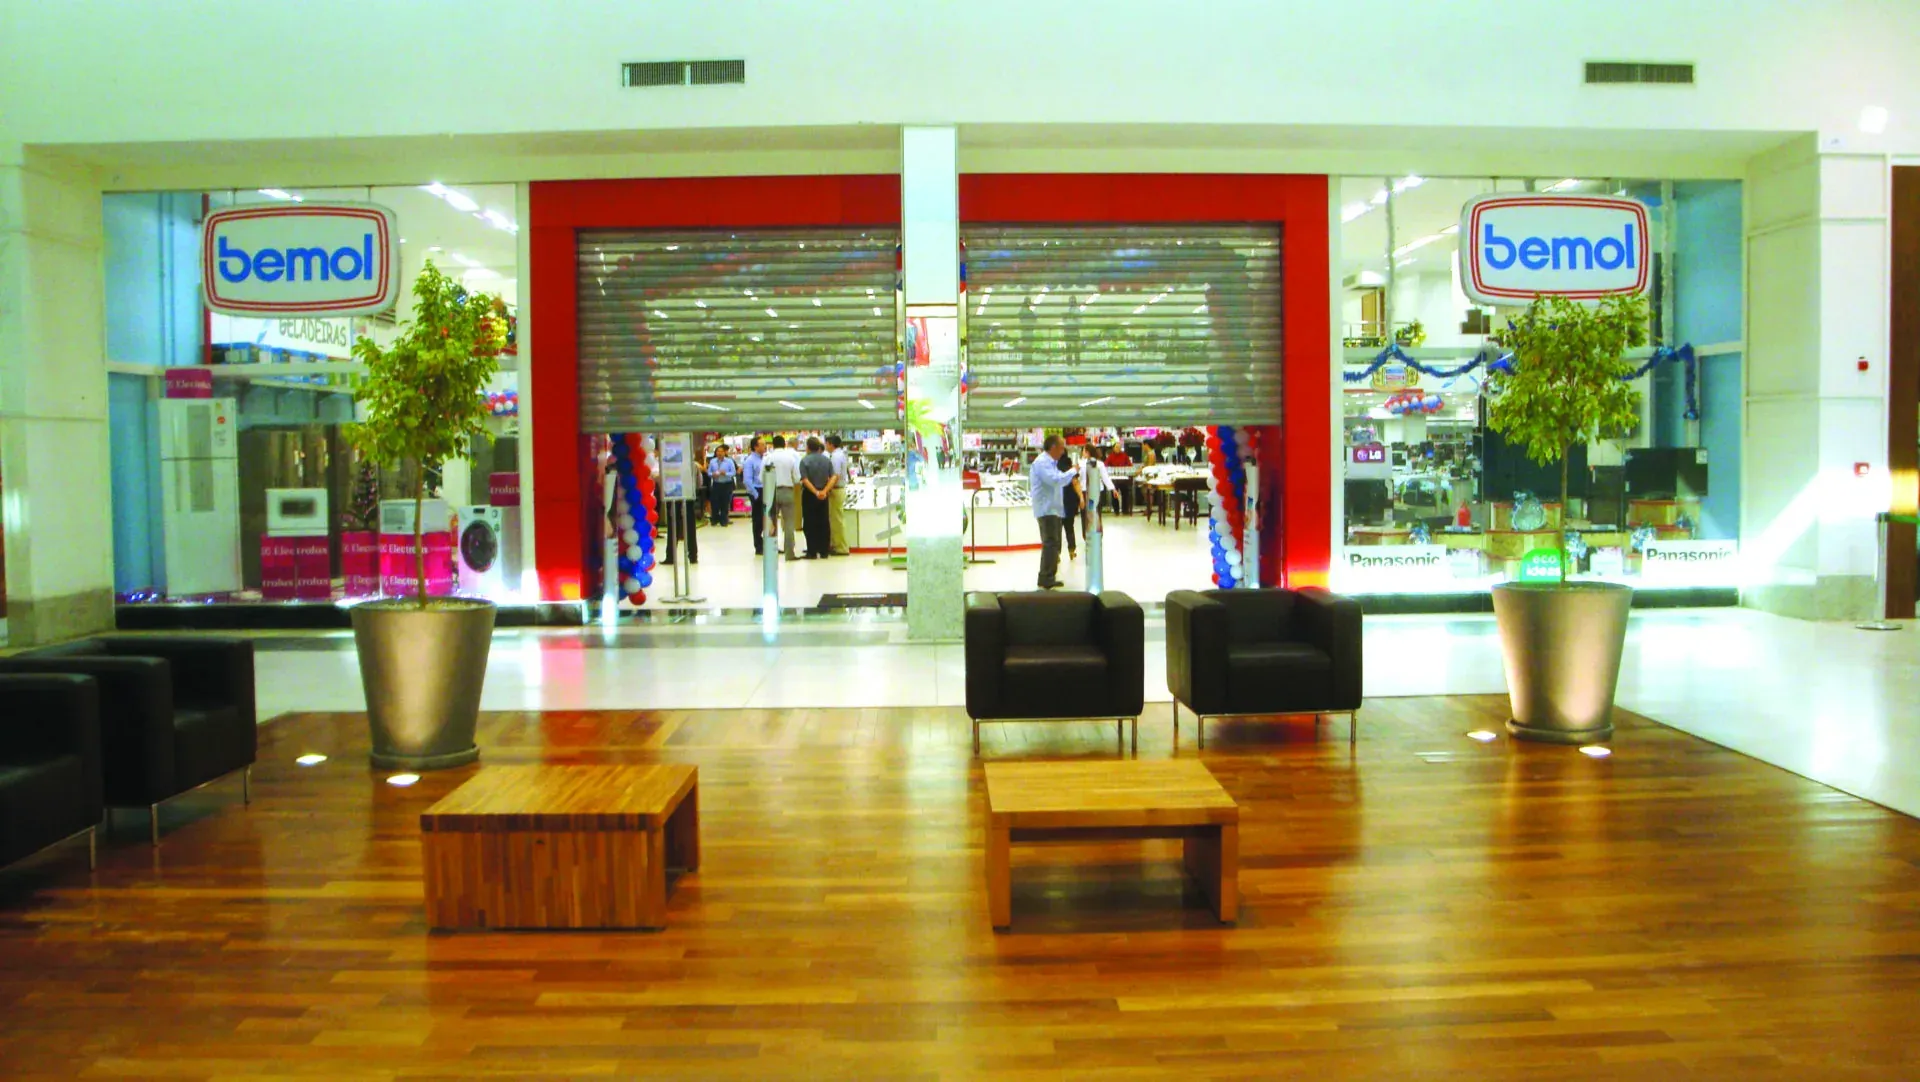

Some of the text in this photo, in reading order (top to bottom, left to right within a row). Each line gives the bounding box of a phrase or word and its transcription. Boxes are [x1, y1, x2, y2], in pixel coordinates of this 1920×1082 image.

[1484, 223, 1635, 271] bemol
[218, 233, 373, 283] bemol
[279, 317, 347, 347] GELADEIRAS
[1368, 449, 1383, 460] LG
[1349, 552, 1441, 568] Panasonic
[1532, 555, 1557, 565] eco
[1646, 547, 1733, 562] Panasonic
